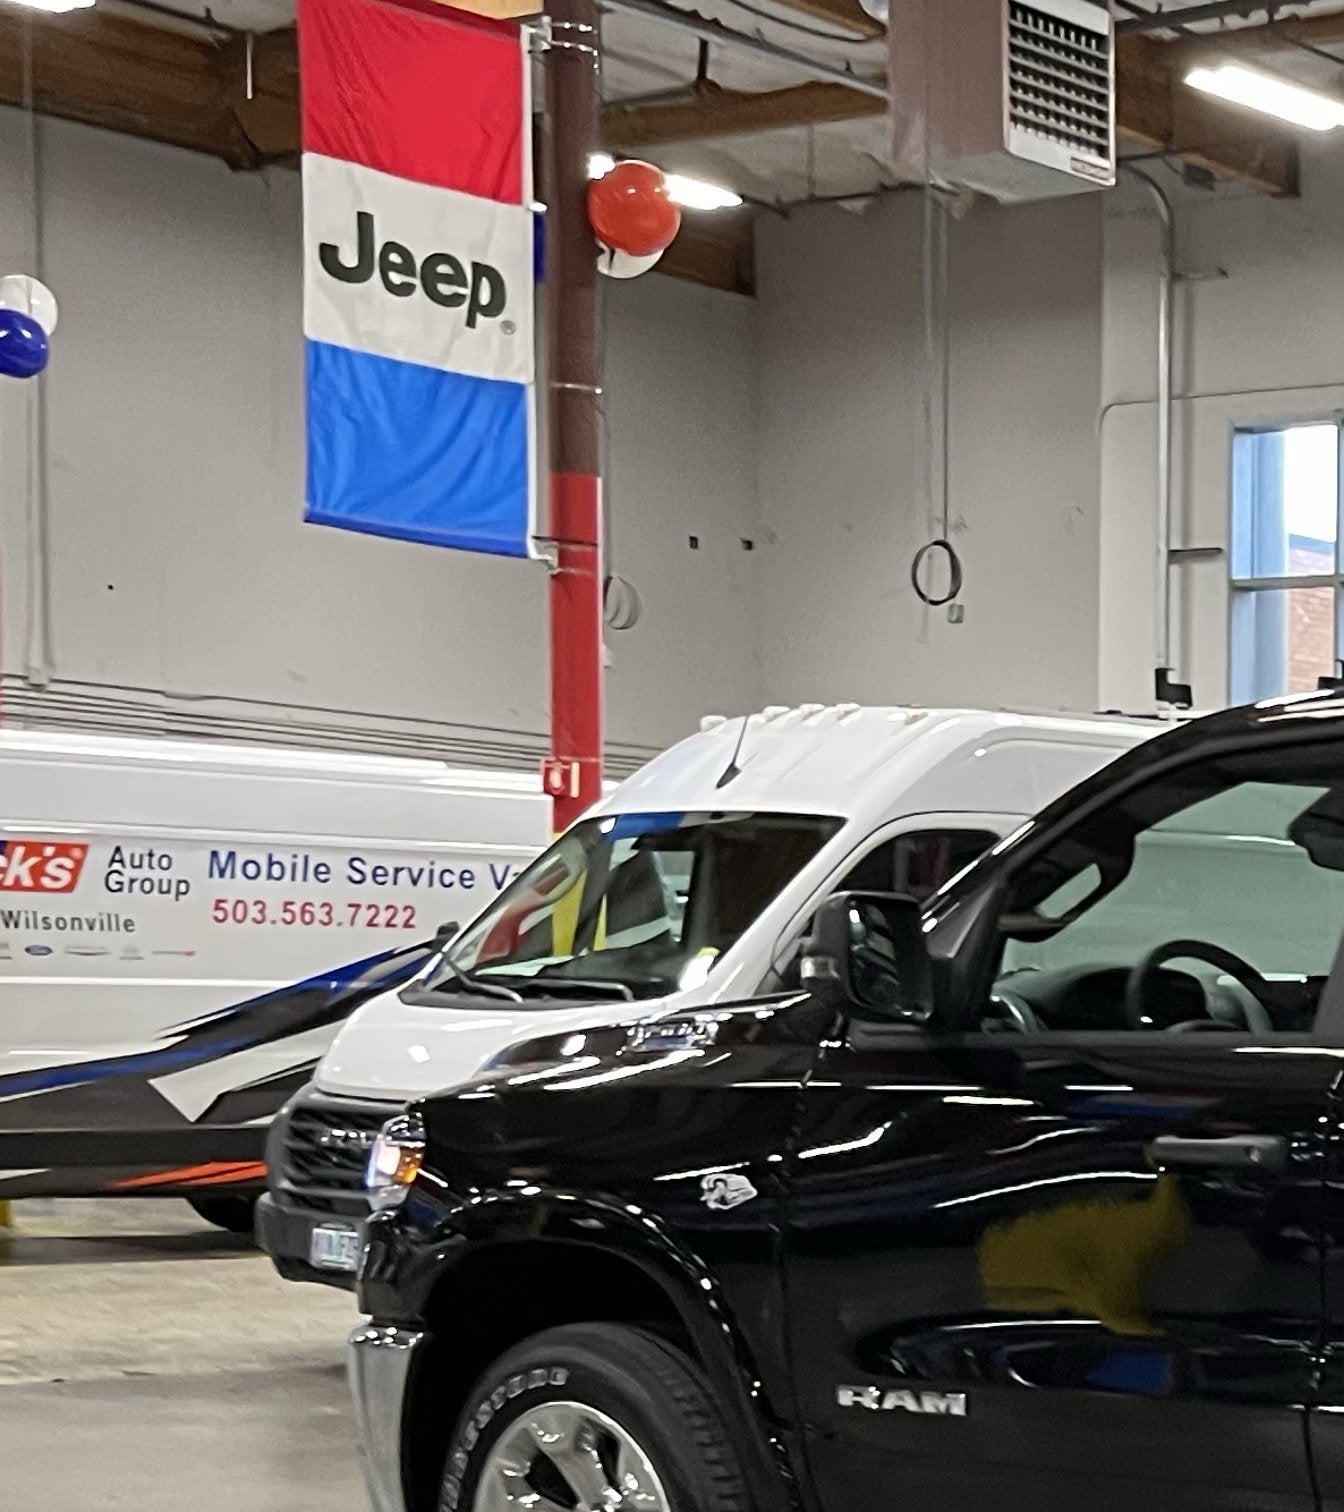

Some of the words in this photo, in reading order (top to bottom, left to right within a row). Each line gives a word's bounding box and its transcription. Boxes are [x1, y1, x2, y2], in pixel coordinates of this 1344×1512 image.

[318, 210, 507, 330] Jeep
[107, 845, 173, 871] Auto
[207, 850, 332, 884] Mobile
[346, 856, 476, 890] Service
[489, 863, 521, 891] V
[104, 869, 191, 902] Group
[0, 909, 137, 933] Wilsonville
[211, 898, 417, 929] 503.563.7222
[837, 1384, 967, 1417] RAM
